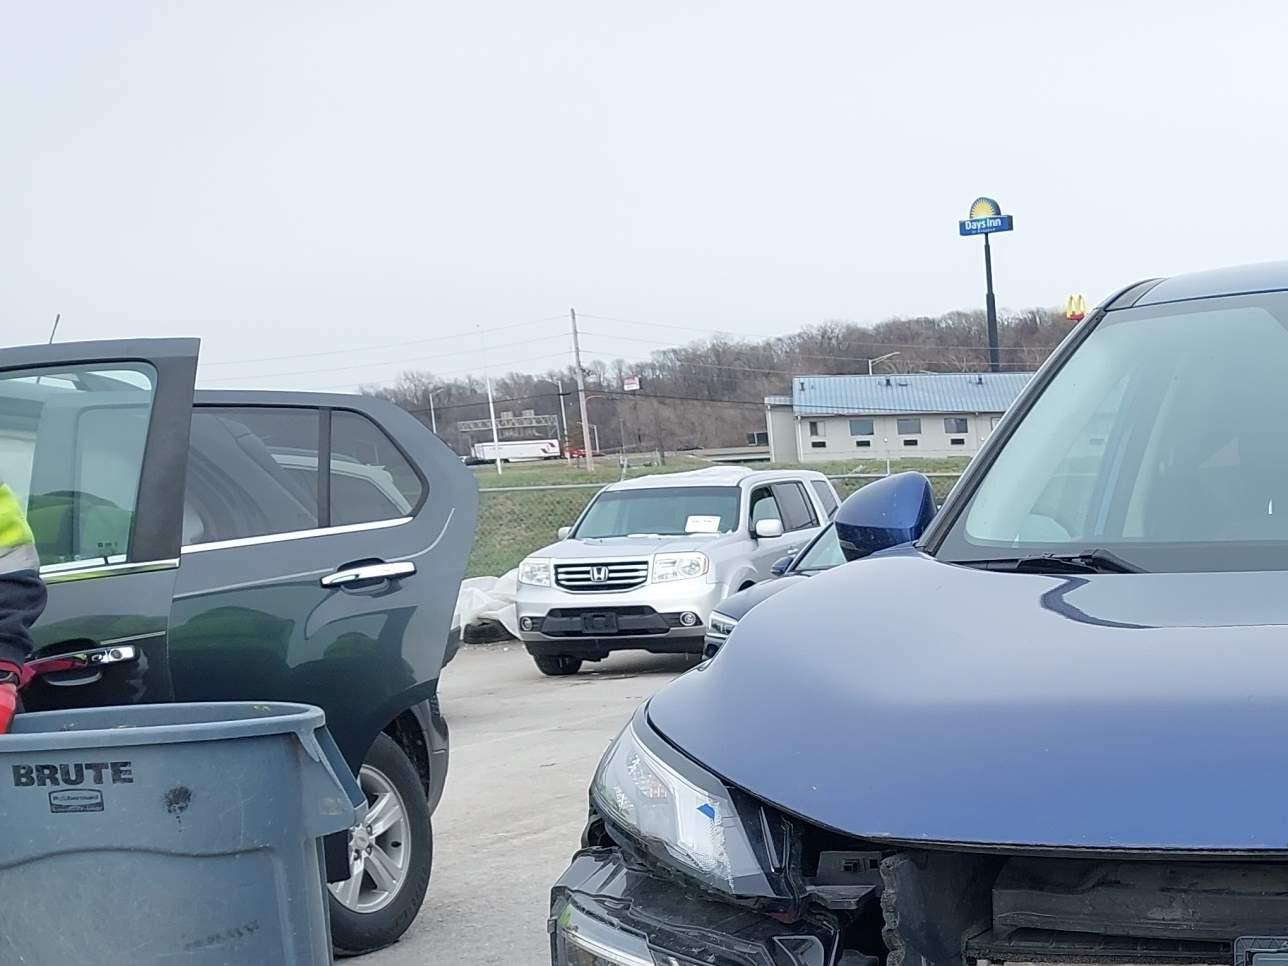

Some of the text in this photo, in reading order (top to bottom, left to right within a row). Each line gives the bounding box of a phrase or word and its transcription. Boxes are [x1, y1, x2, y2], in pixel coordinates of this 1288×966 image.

[965, 220, 985, 231] Days
[986, 218, 1001, 227] Inn
[12, 761, 134, 787] BRUTE
